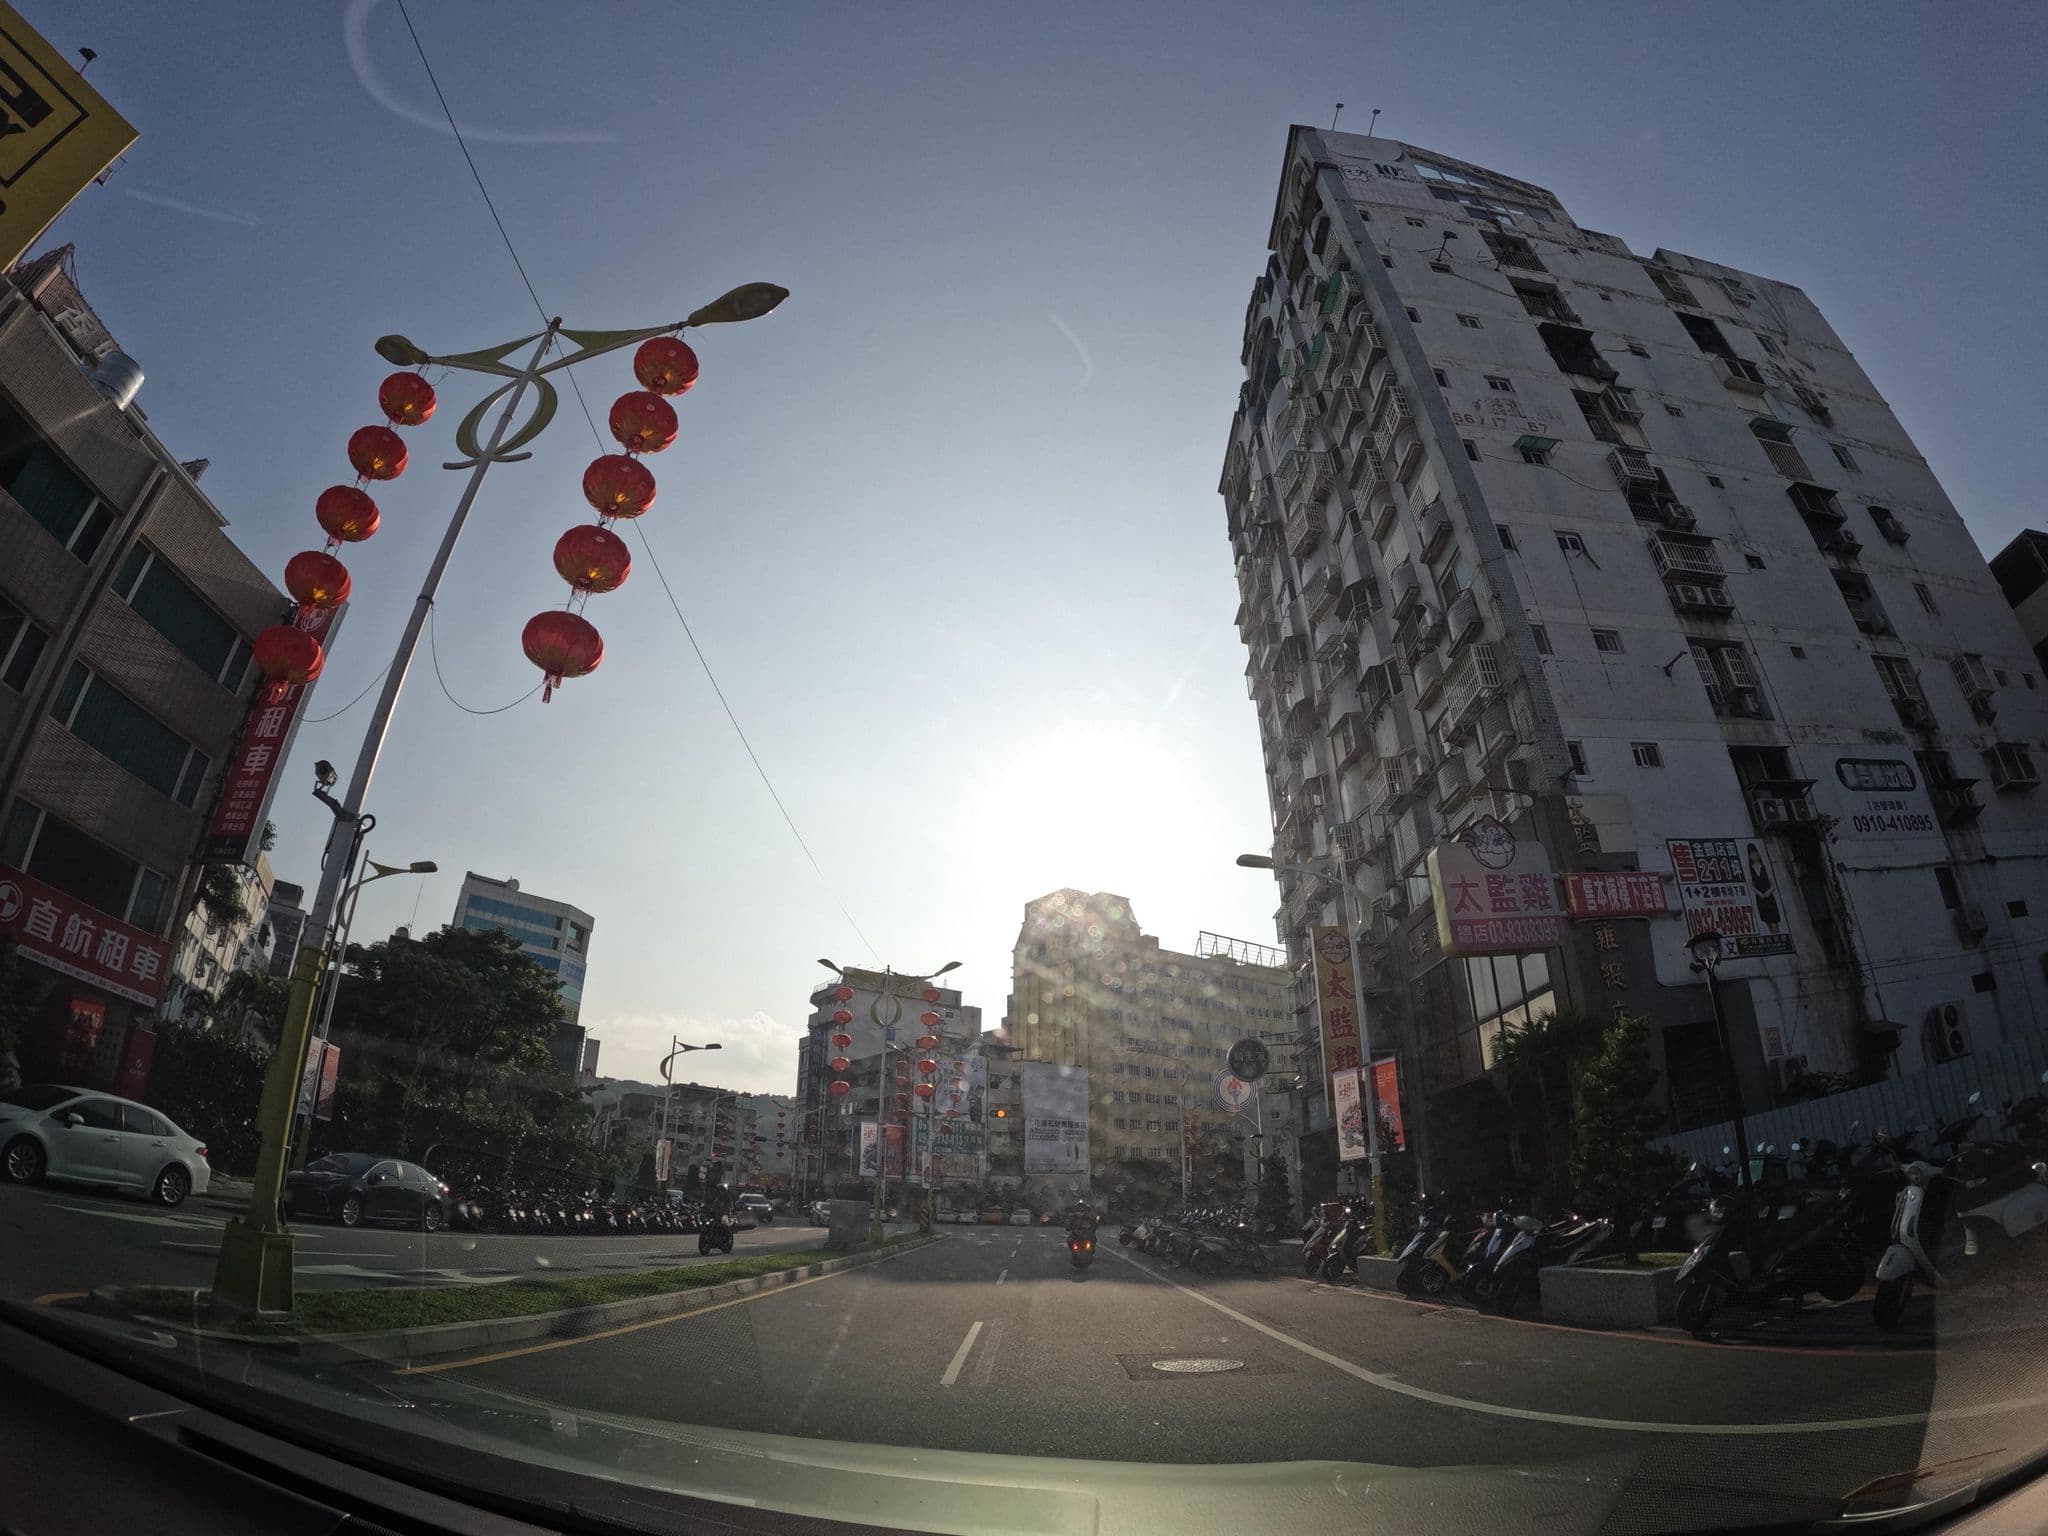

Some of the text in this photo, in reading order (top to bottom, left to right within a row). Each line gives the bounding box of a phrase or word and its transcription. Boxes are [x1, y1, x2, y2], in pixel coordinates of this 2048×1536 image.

[1853, 815, 1933, 833] 0910-410895
[1672, 842, 1698, 882] 售
[23, 897, 163, 982] 直航租車
